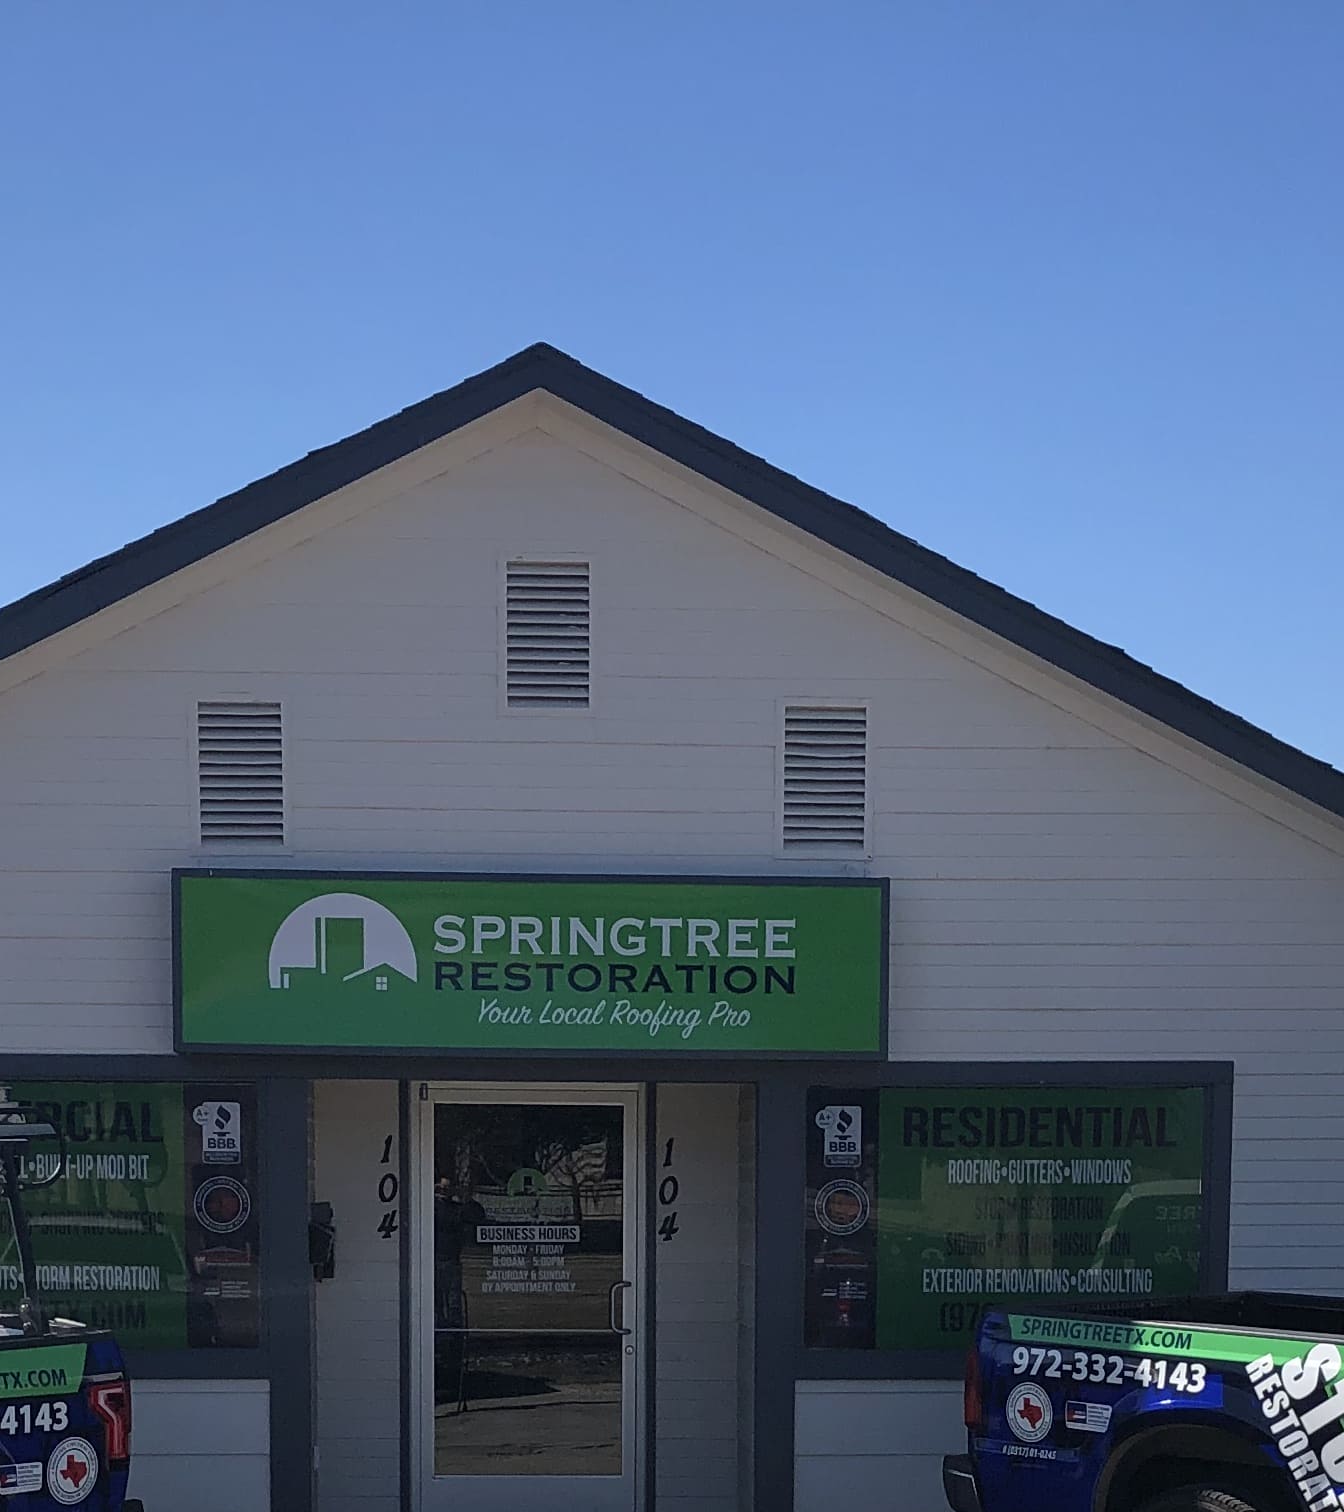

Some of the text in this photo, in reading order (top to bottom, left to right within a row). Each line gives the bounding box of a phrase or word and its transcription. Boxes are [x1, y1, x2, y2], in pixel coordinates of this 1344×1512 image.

[433, 914, 797, 960] SPRINGTREE
[434, 961, 797, 995] RESTORATION
[476, 998, 751, 1039] Your Local Roofing Pro
[902, 1106, 1177, 1149] RESIDENTIAL
[207, 1137, 236, 1149] BBB
[829, 1141, 857, 1153] BBB
[96, 1154, 125, 1180] MOD
[128, 1154, 149, 1180] BIT
[480, 1227, 577, 1241] BUSINESS HOURS
[492, 1244, 528, 1255] MONDAY
[535, 1244, 565, 1255] FRIDAY
[35, 1264, 71, 1291] TORM
[73, 1264, 161, 1292] RESTORATION
[481, 1282, 576, 1293] BY APPOINTMENT ONLY
[486, 1270, 529, 1280] SATURDAY
[538, 1270, 572, 1280] SUNDAY
[922, 1268, 984, 1294] EXTERIOR
[1020, 1316, 1193, 1351] SPRINGTREETX.COM
[1012, 1345, 1207, 1394] 972-332-4143
